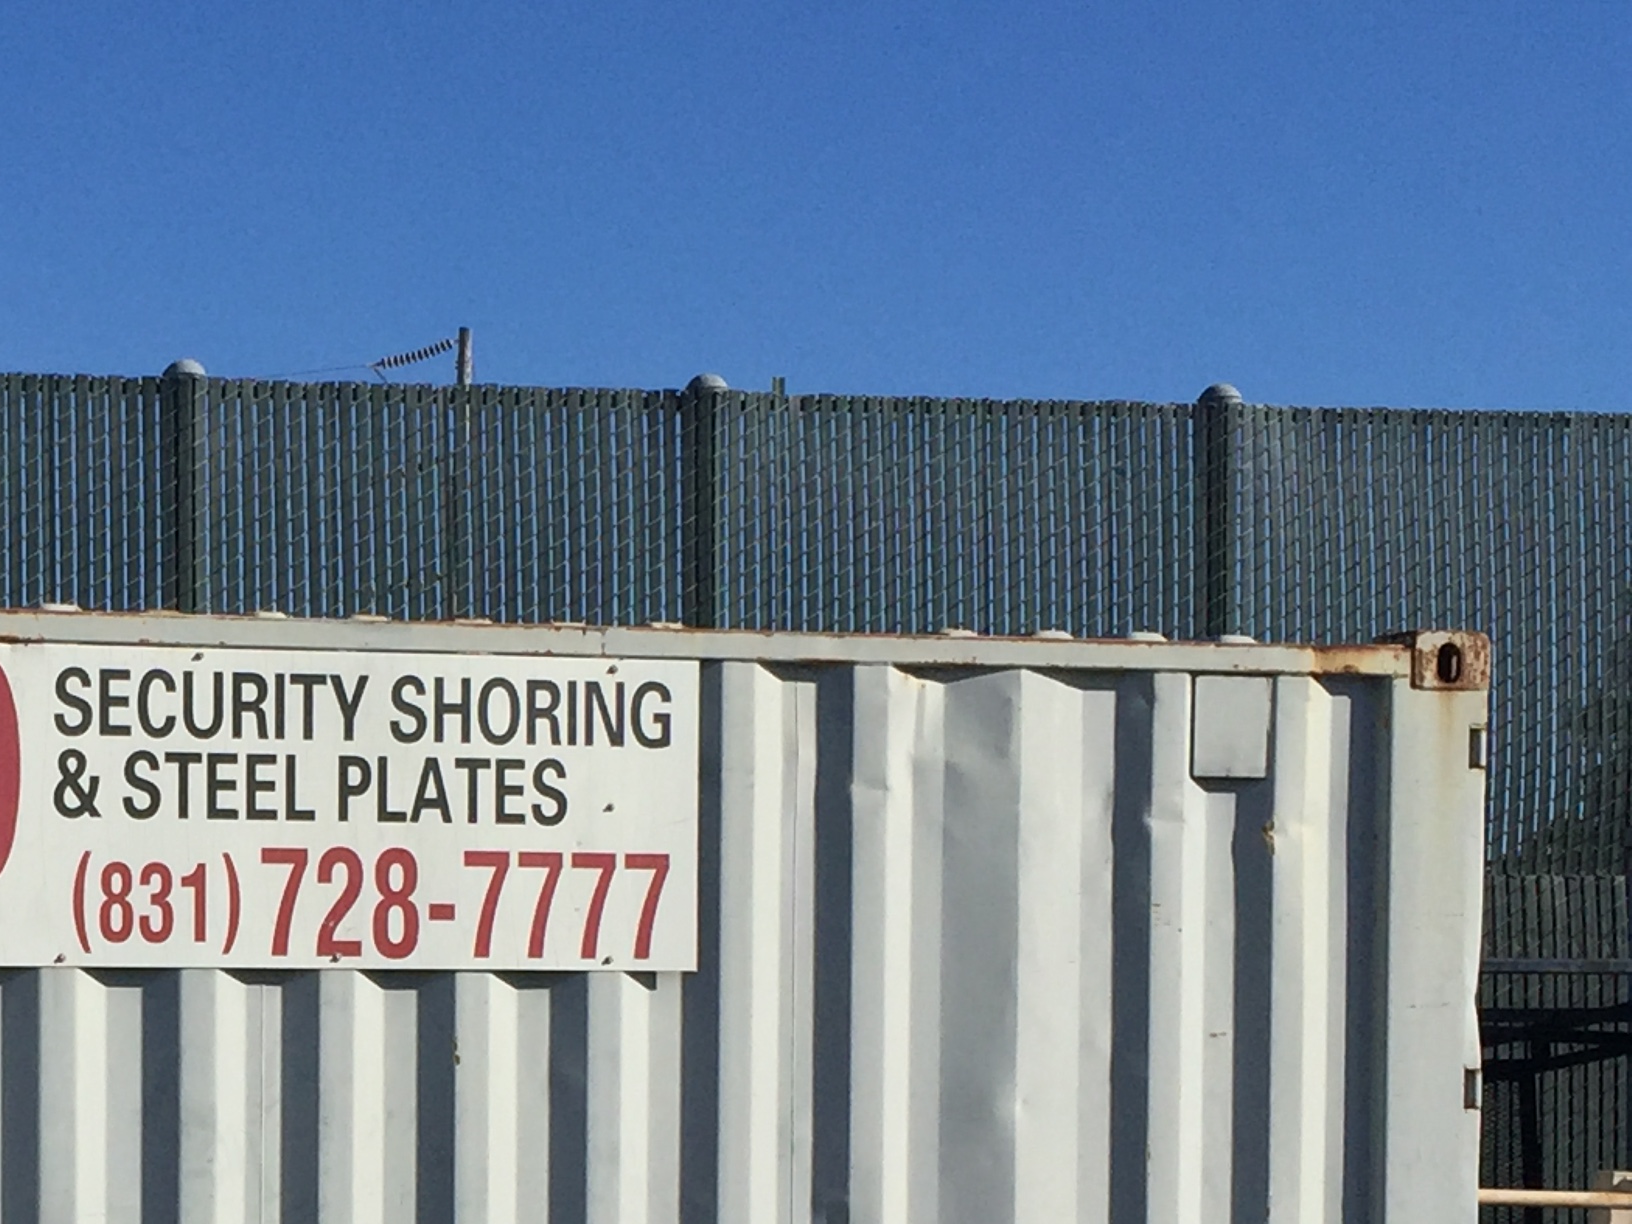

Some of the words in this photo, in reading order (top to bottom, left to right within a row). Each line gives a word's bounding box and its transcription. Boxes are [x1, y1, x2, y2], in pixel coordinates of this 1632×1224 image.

[53, 666, 369, 741] SECURITY
[389, 674, 672, 749] SHORING
[53, 748, 102, 820] &
[122, 749, 316, 821] STEEL
[338, 755, 568, 827] PLATES
[73, 848, 239, 952] (831)
[260, 847, 668, 959] 728-7777
